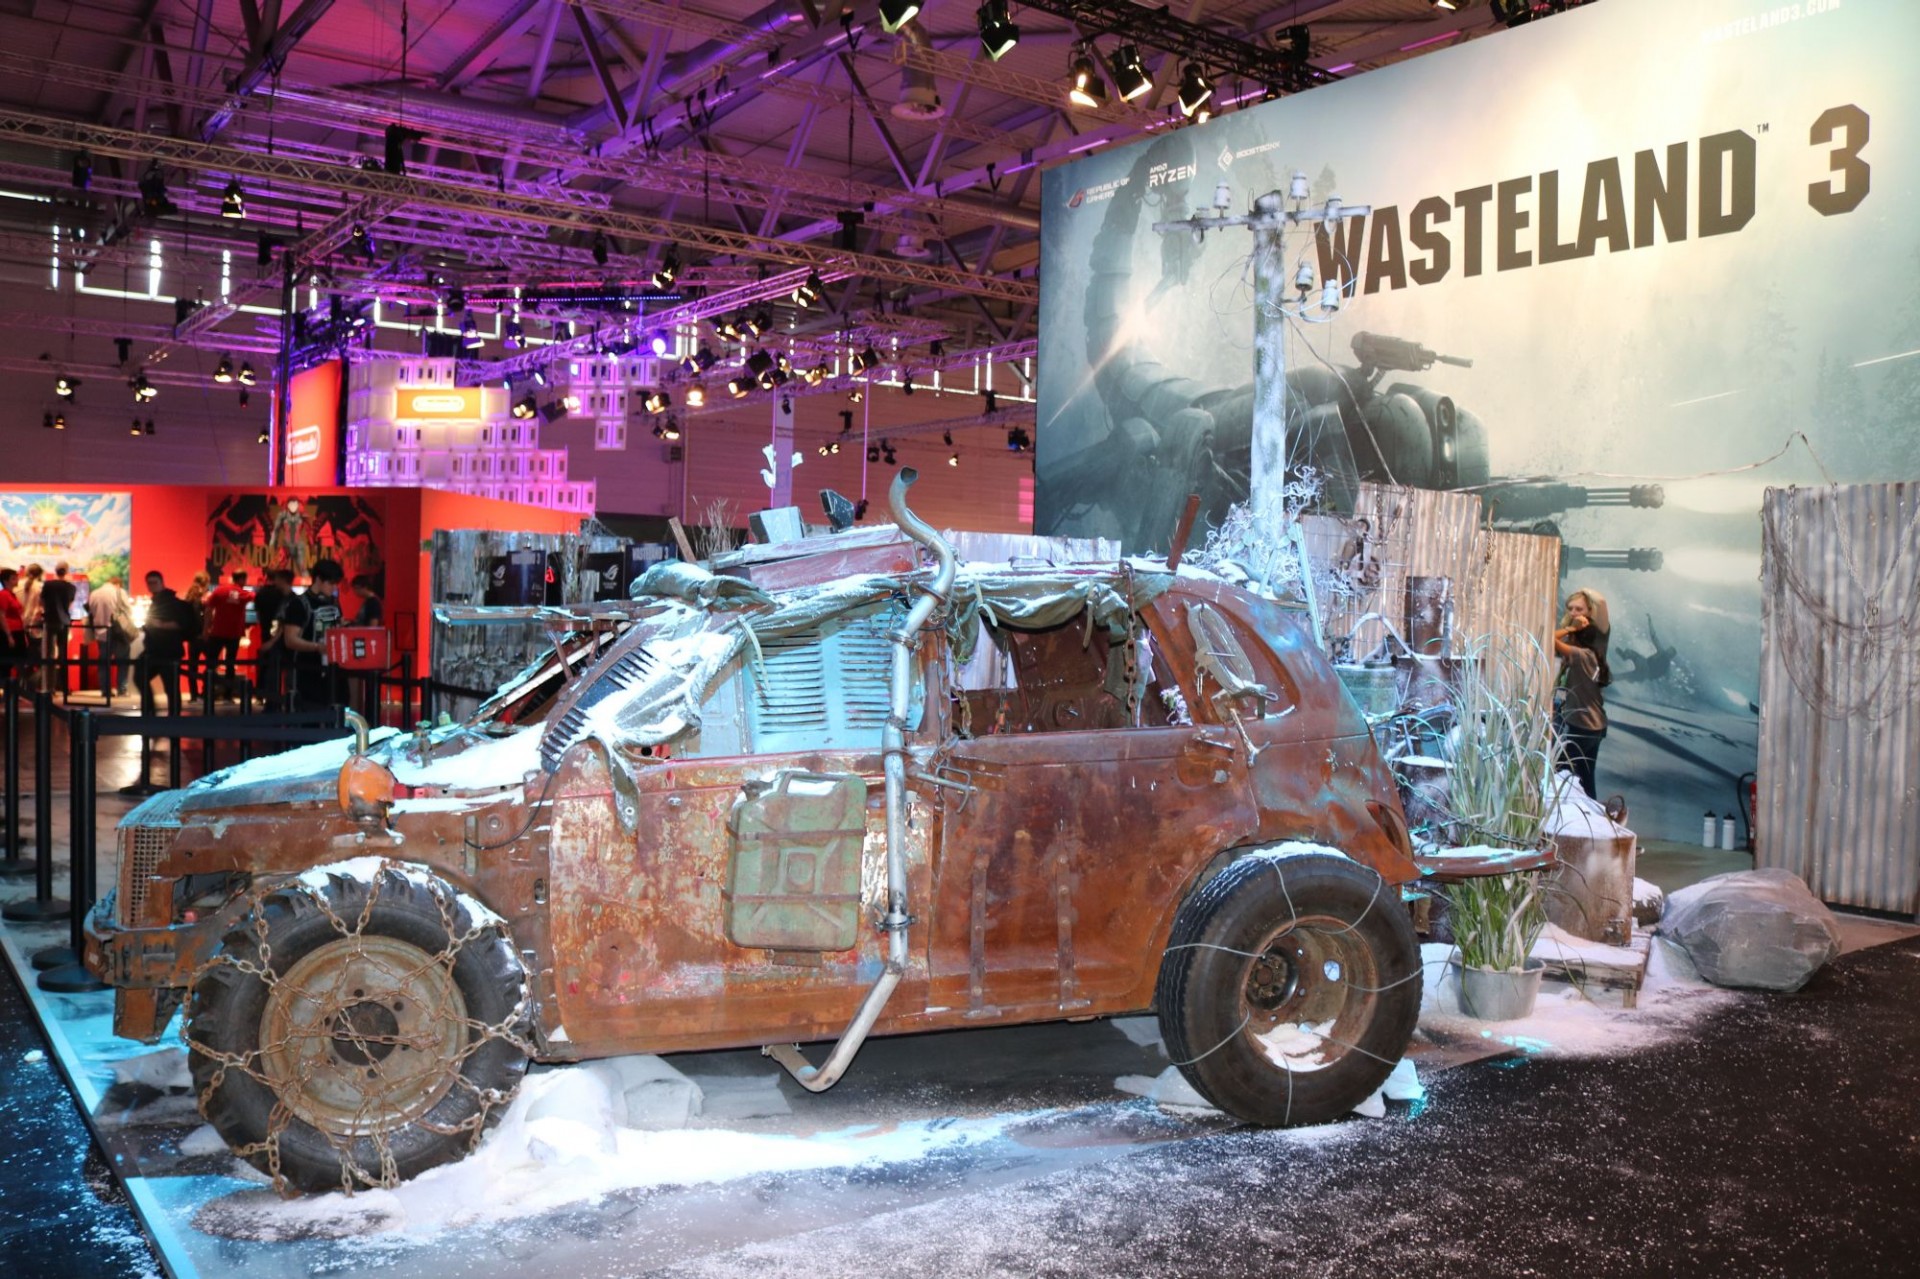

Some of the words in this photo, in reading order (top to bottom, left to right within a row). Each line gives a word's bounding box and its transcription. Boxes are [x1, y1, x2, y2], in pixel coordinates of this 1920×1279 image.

[1150, 163, 1197, 188] RYZEN
[1313, 128, 1757, 299] WASTELAND
[1808, 103, 1870, 217] 3
